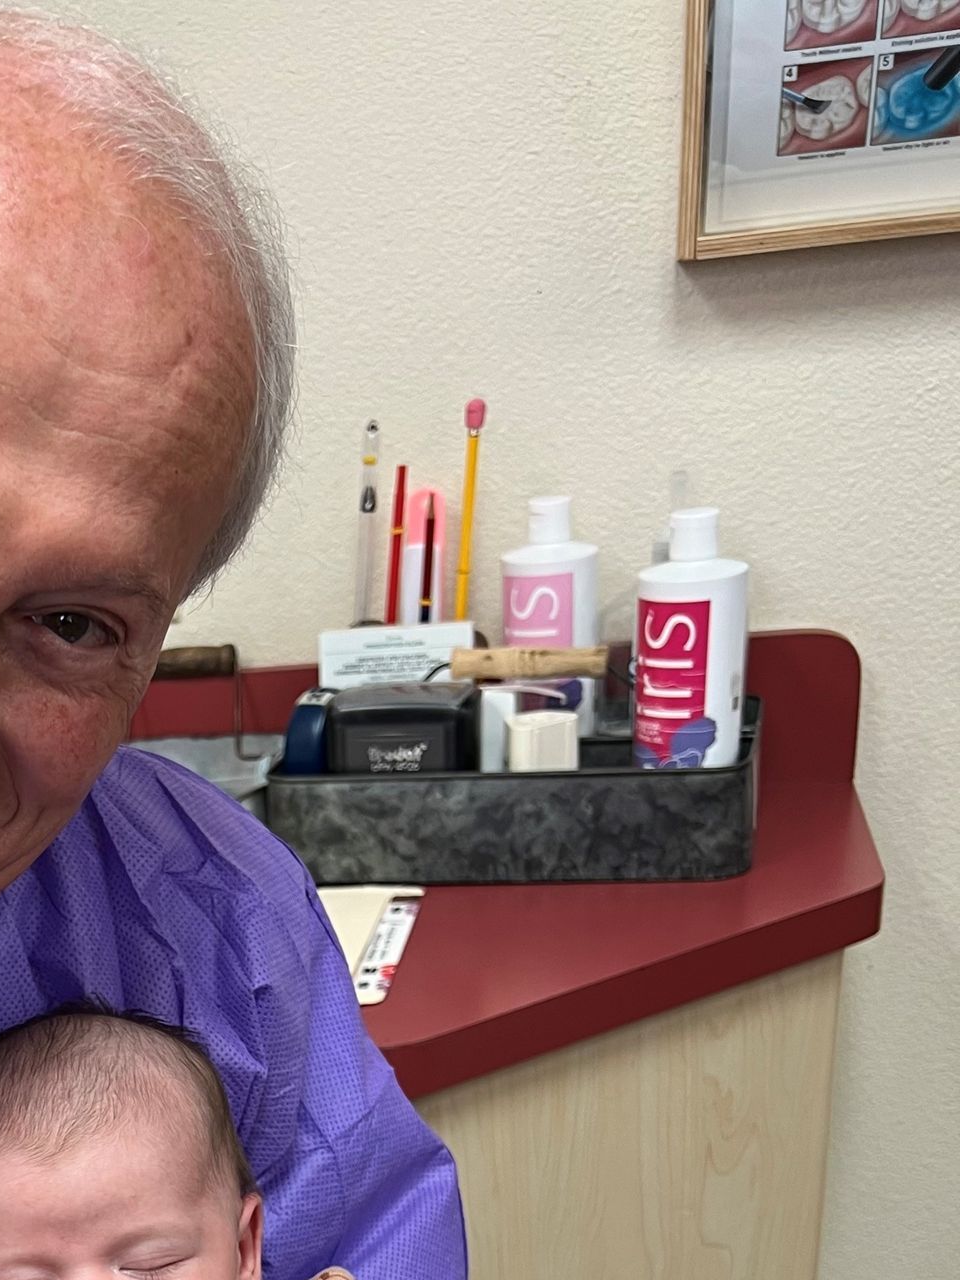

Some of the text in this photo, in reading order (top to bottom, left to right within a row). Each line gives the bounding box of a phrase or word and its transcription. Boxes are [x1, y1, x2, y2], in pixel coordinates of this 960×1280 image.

[882, 57, 890, 66] 5
[786, 68, 794, 78] 4
[636, 608, 697, 720] iris
